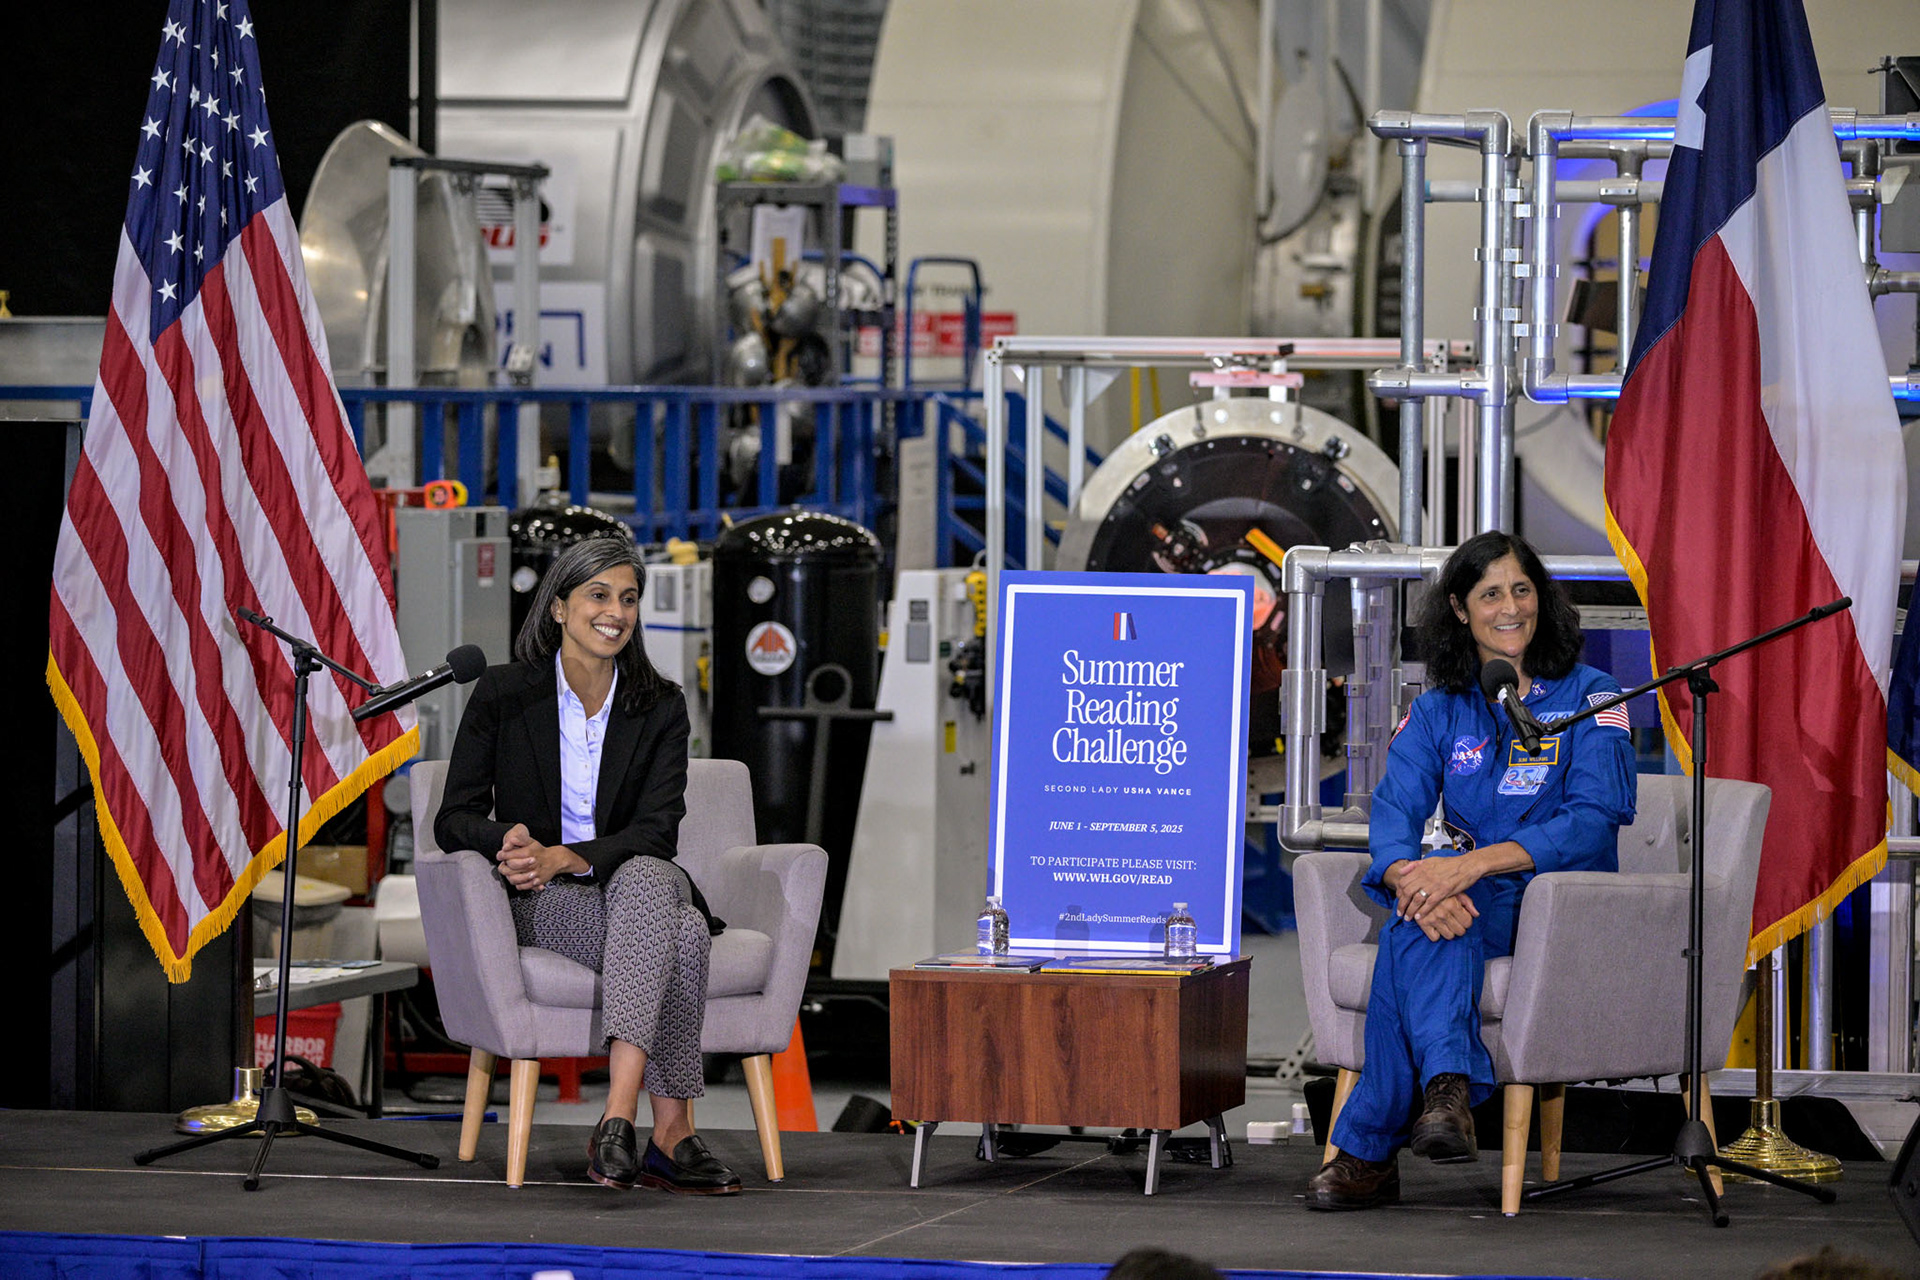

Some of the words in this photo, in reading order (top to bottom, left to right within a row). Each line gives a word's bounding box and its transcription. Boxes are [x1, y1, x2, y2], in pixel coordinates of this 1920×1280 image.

[1062, 649, 1185, 687] Summer
[1064, 689, 1180, 736] Reading
[1052, 727, 1188, 775] Challenge
[1451, 750, 1483, 761] NASA
[1044, 784, 1088, 793] SECOND
[1091, 786, 1119, 794] LADY
[1123, 787, 1152, 795] USHA
[1156, 787, 1192, 796] VANCE
[1049, 821, 1075, 831] JUNE
[1076, 822, 1082, 831] 1
[1089, 822, 1148, 833] SEPTEMBER
[1149, 823, 1159, 835] 5,
[1160, 824, 1184, 834] 2025
[1030, 855, 1046, 866] TO
[1048, 856, 1119, 868] PARTICIPATE
[1121, 858, 1163, 869] PLEASE
[1165, 859, 1197, 871] VISIT:
[1052, 871, 1173, 886] WWW.WH.GOV/READ
[1058, 912, 1167, 925] #2ndLadySummerReads
